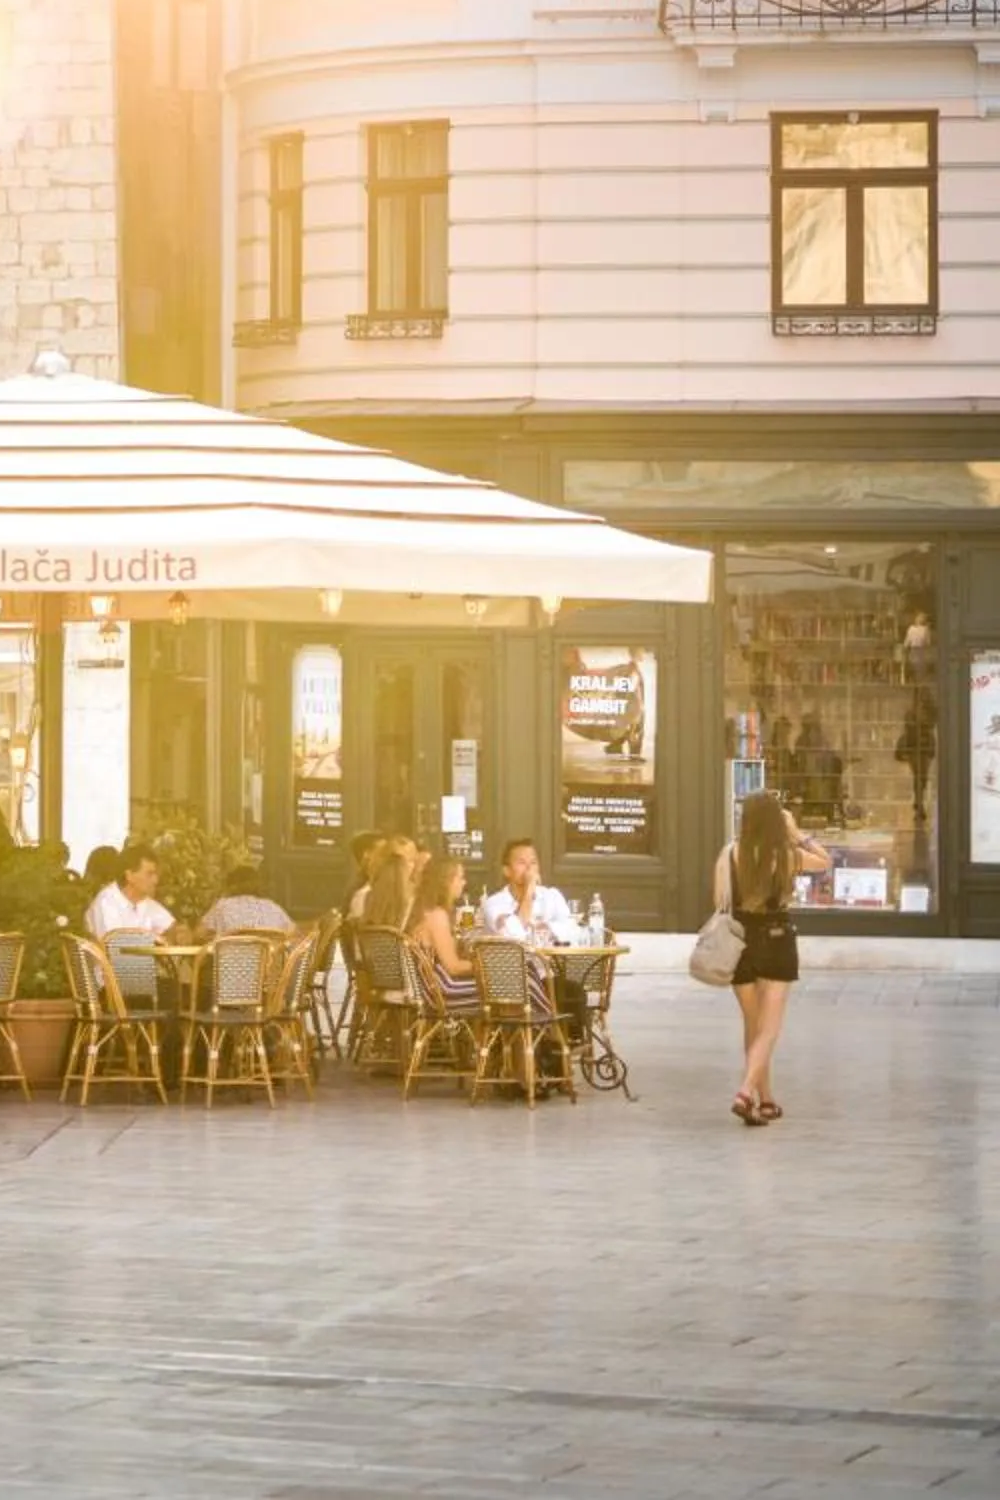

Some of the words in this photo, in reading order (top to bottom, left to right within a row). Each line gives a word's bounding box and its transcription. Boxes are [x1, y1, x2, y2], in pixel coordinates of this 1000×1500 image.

[84, 548, 197, 582] Judita
[569, 675, 639, 693] KRALJEV
[568, 697, 628, 715] GAMBIT
